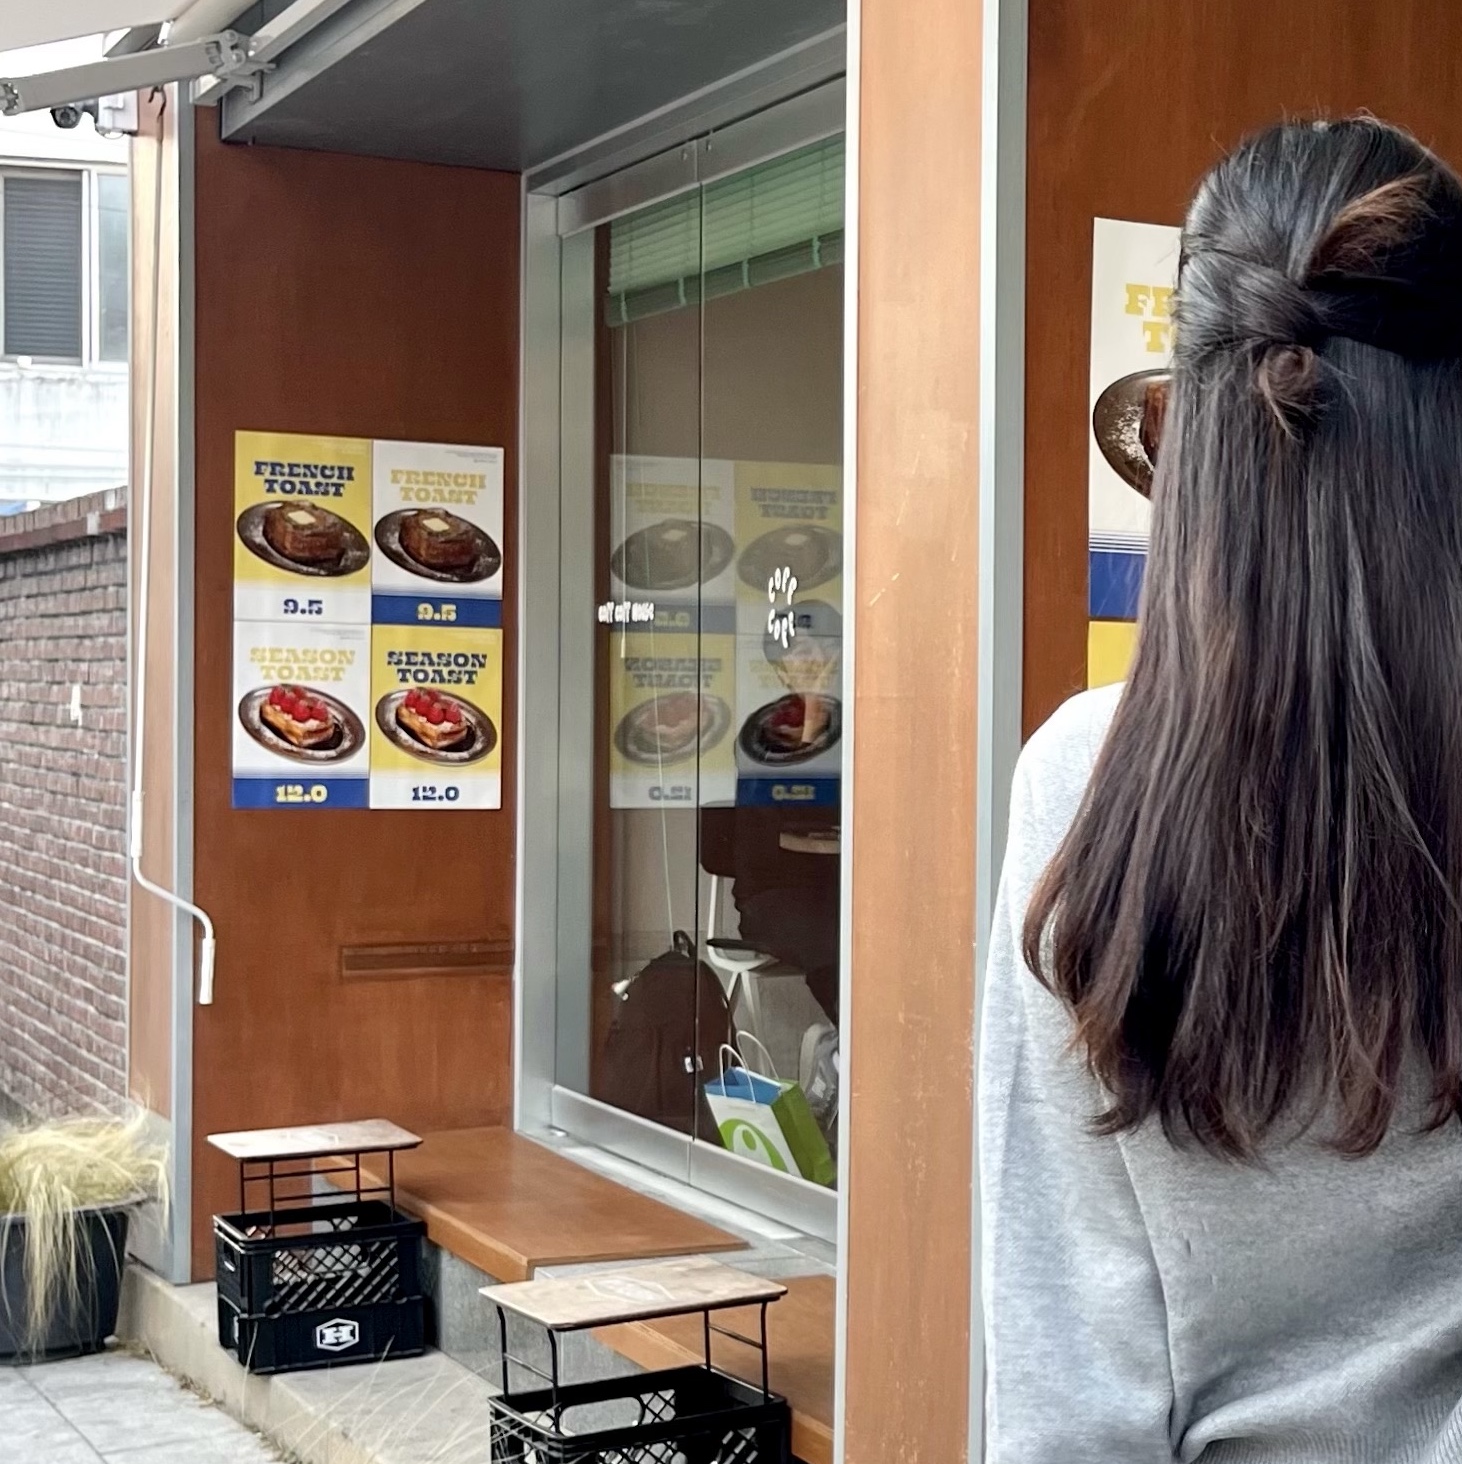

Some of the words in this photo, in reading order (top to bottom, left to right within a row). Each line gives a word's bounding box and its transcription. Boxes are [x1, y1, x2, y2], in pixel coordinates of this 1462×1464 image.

[254, 461, 355, 481] FRENCH
[391, 469, 487, 489] FRENCH
[264, 479, 346, 497] TOAST
[400, 487, 478, 505] TOAST
[283, 599, 323, 615] 9.5
[417, 602, 457, 622] 9.5
[250, 646, 356, 666] SEASON
[387, 650, 488, 669] SEASON
[260, 665, 345, 682] TOAST
[397, 668, 478, 685] TOAST
[275, 783, 328, 803] 12.0
[412, 786, 460, 801] 12.0
